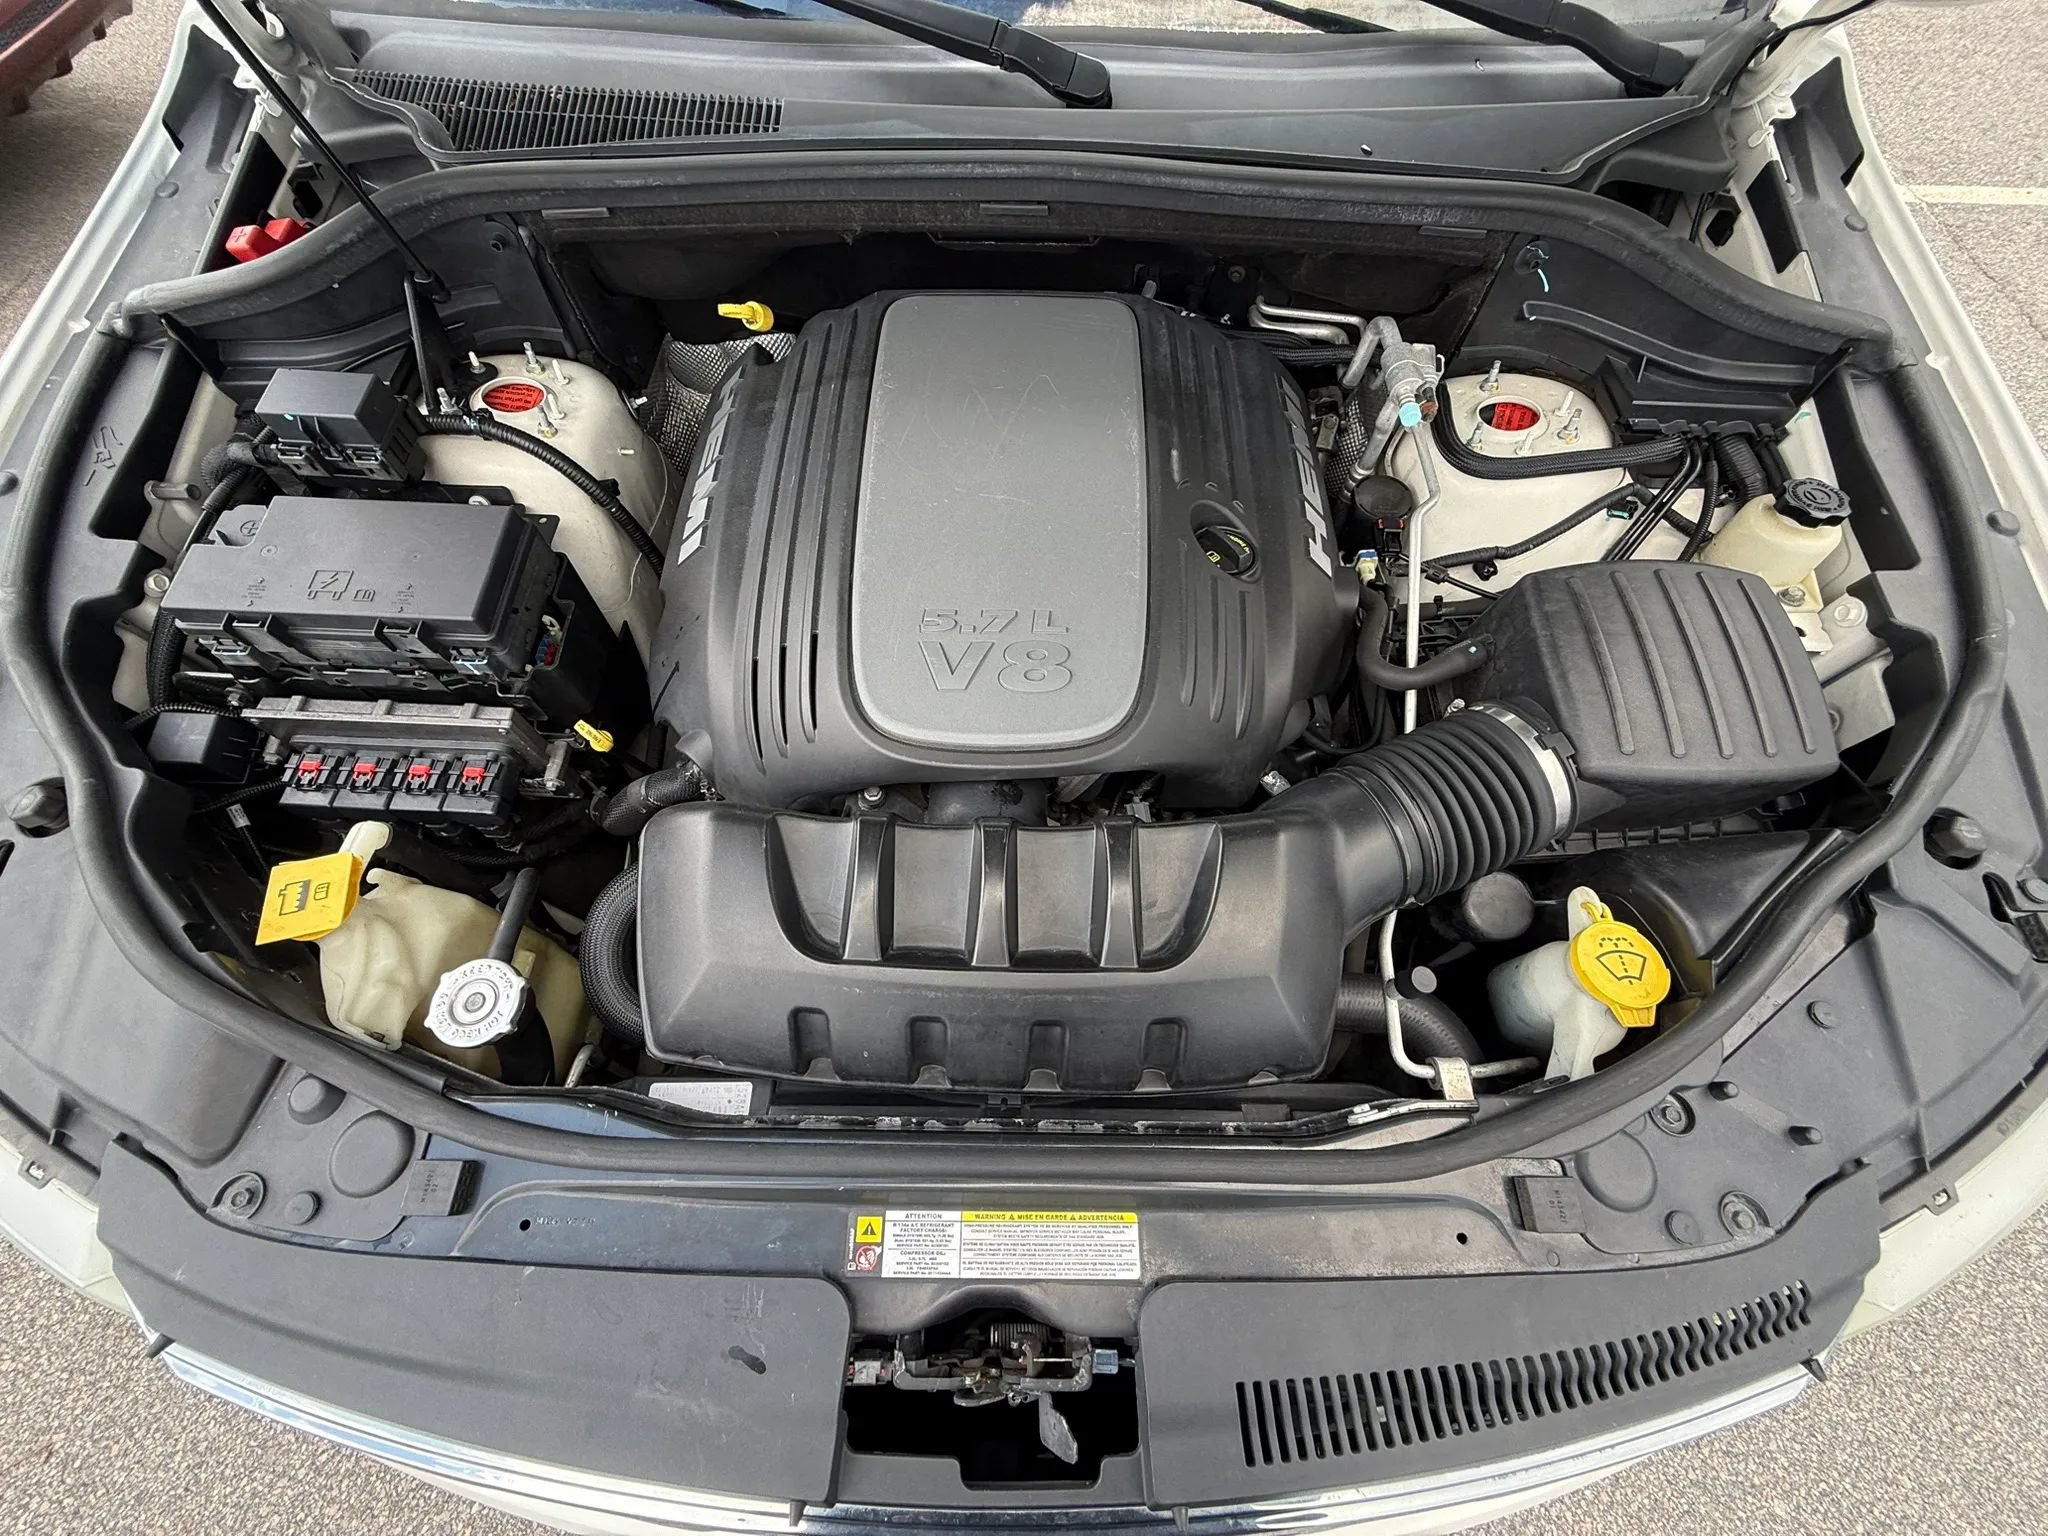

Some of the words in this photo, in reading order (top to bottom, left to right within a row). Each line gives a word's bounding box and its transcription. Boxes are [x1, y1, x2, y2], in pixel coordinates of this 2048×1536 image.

[678, 366, 743, 566] HEMI
[1281, 376, 1332, 578] HEMI
[919, 640, 1073, 693] V8
